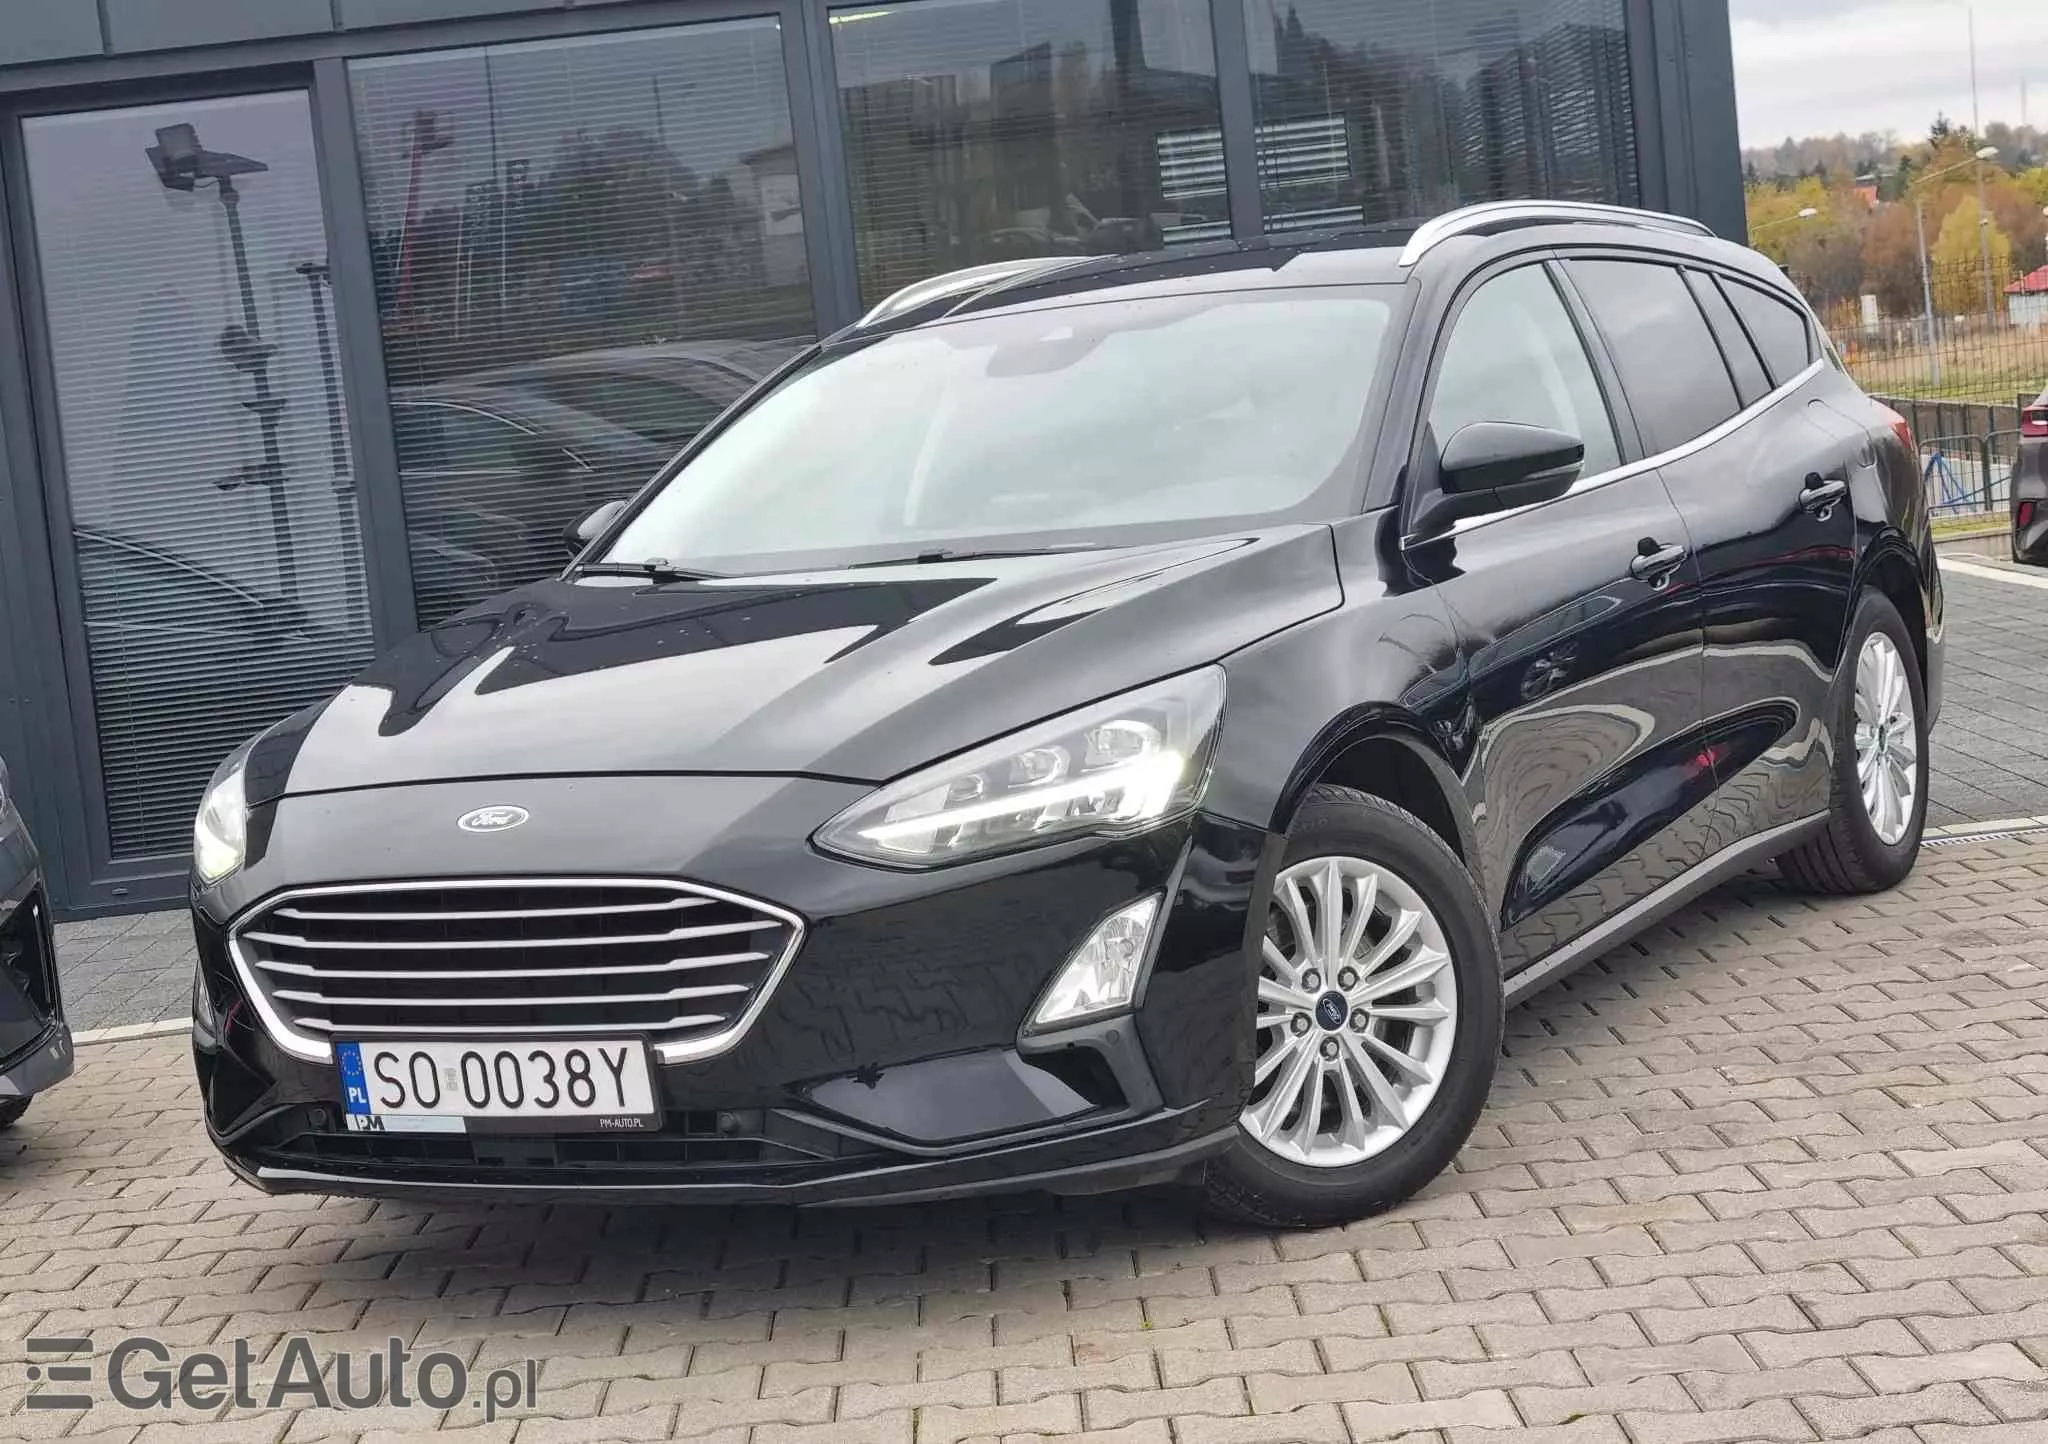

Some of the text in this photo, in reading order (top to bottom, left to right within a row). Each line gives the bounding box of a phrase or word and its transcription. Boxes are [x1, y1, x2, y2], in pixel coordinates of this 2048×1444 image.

[374, 1047, 628, 1108] SO 0038Y
[348, 1087, 367, 1103] PL
[600, 1118, 645, 1128] PM-AUTO.PL
